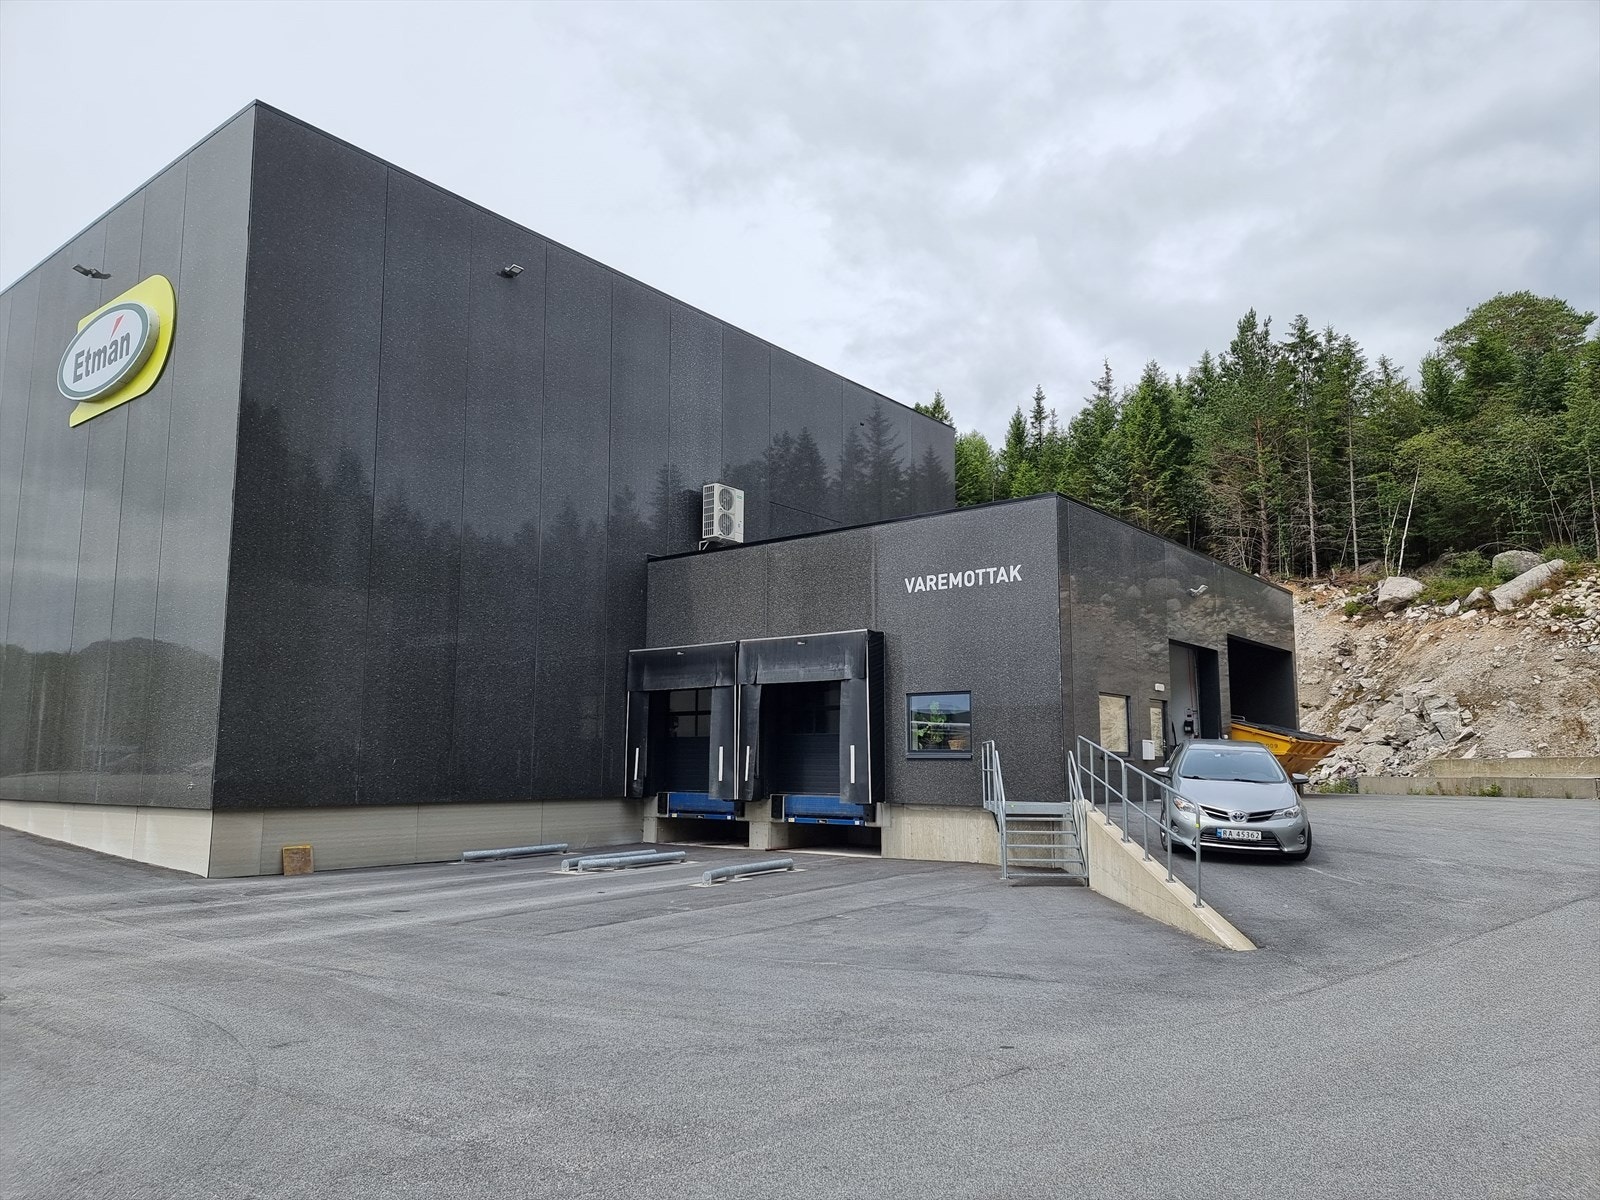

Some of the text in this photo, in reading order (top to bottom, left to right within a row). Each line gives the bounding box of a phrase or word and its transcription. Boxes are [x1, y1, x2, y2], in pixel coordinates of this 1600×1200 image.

[904, 564, 1022, 593] VAREMOTTAK
[1222, 829, 1260, 839] RA 45362
